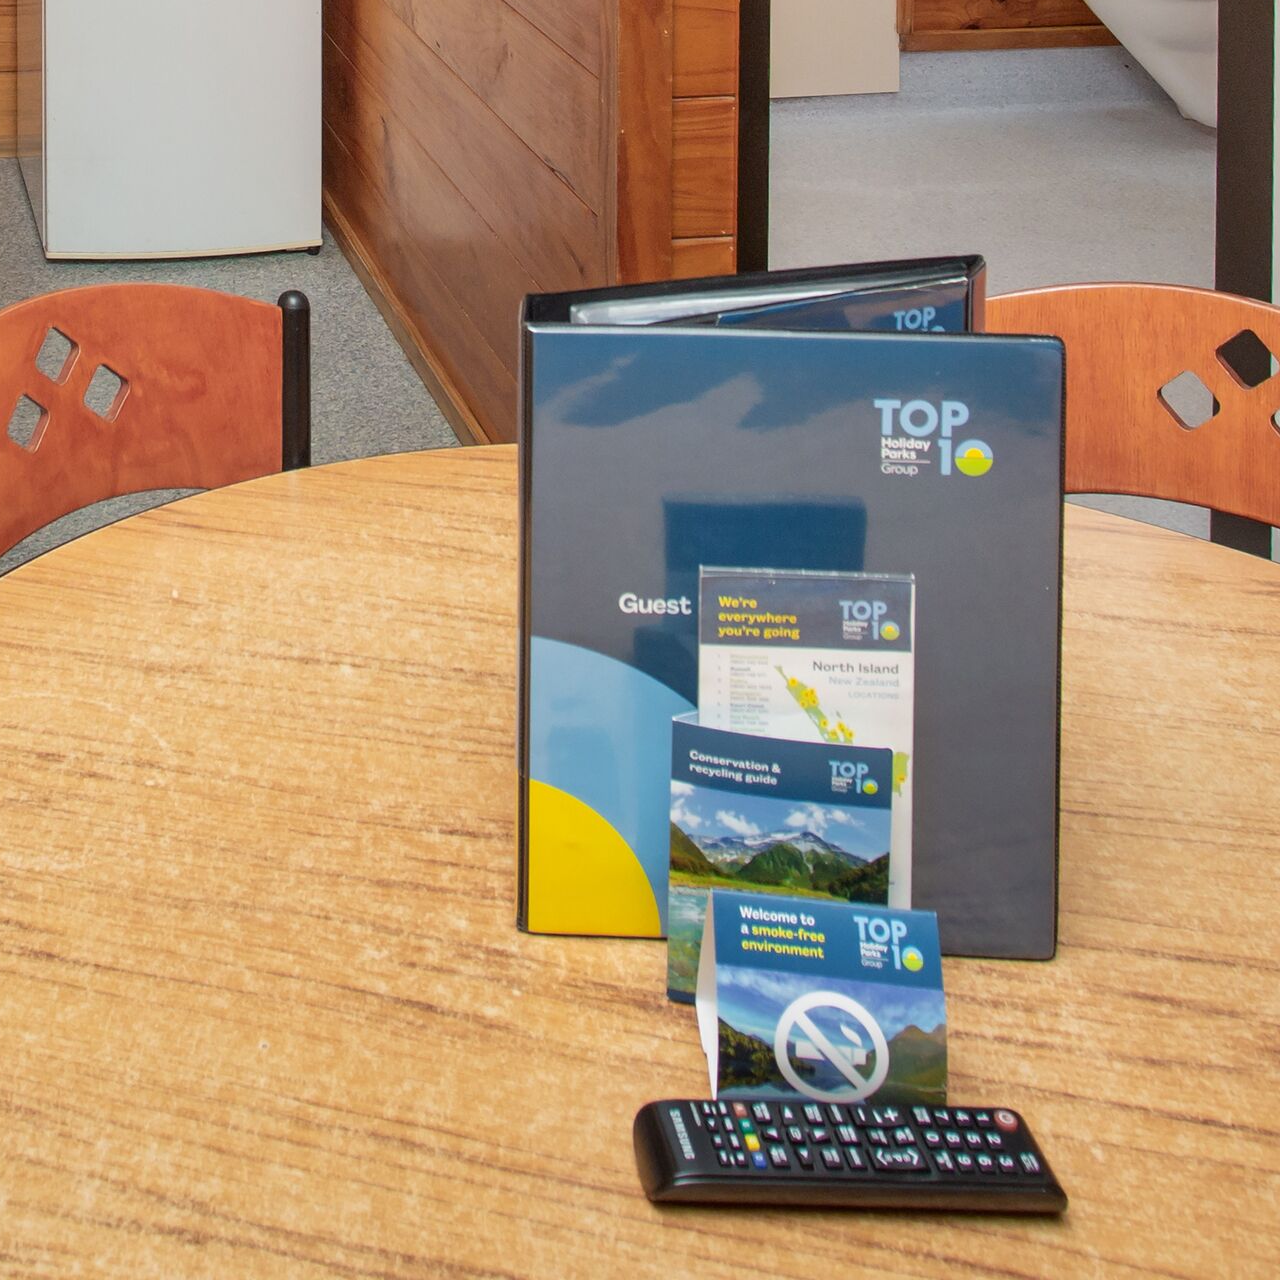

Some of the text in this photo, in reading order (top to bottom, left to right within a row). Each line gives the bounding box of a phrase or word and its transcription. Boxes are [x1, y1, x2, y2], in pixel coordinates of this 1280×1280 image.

[894, 306, 937, 331] TOP
[873, 398, 970, 437] TOP
[881, 437, 931, 453] Holiday
[881, 449, 917, 460] Parks
[881, 463, 919, 477] Group
[618, 593, 693, 616] Guest
[718, 596, 758, 609] We're
[839, 600, 888, 620] TOP
[718, 611, 798, 625] everywhere
[718, 625, 800, 640] you're going
[813, 661, 899, 675] North Island
[828, 676, 899, 688] New Zealand
[848, 691, 899, 700] LOCATIONS
[689, 749, 782, 775] Conservation &
[828, 760, 869, 779] TOP
[689, 763, 778, 786] recycling guide
[739, 905, 816, 927] Welcome to
[740, 924, 826, 944] a smoke-free
[853, 915, 908, 945] TOP
[741, 939, 825, 960] environment
[669, 1107, 696, 1161] SAMSUNG
[985, 1132, 1001, 1145] 2
[999, 1155, 1014, 1168] 3
